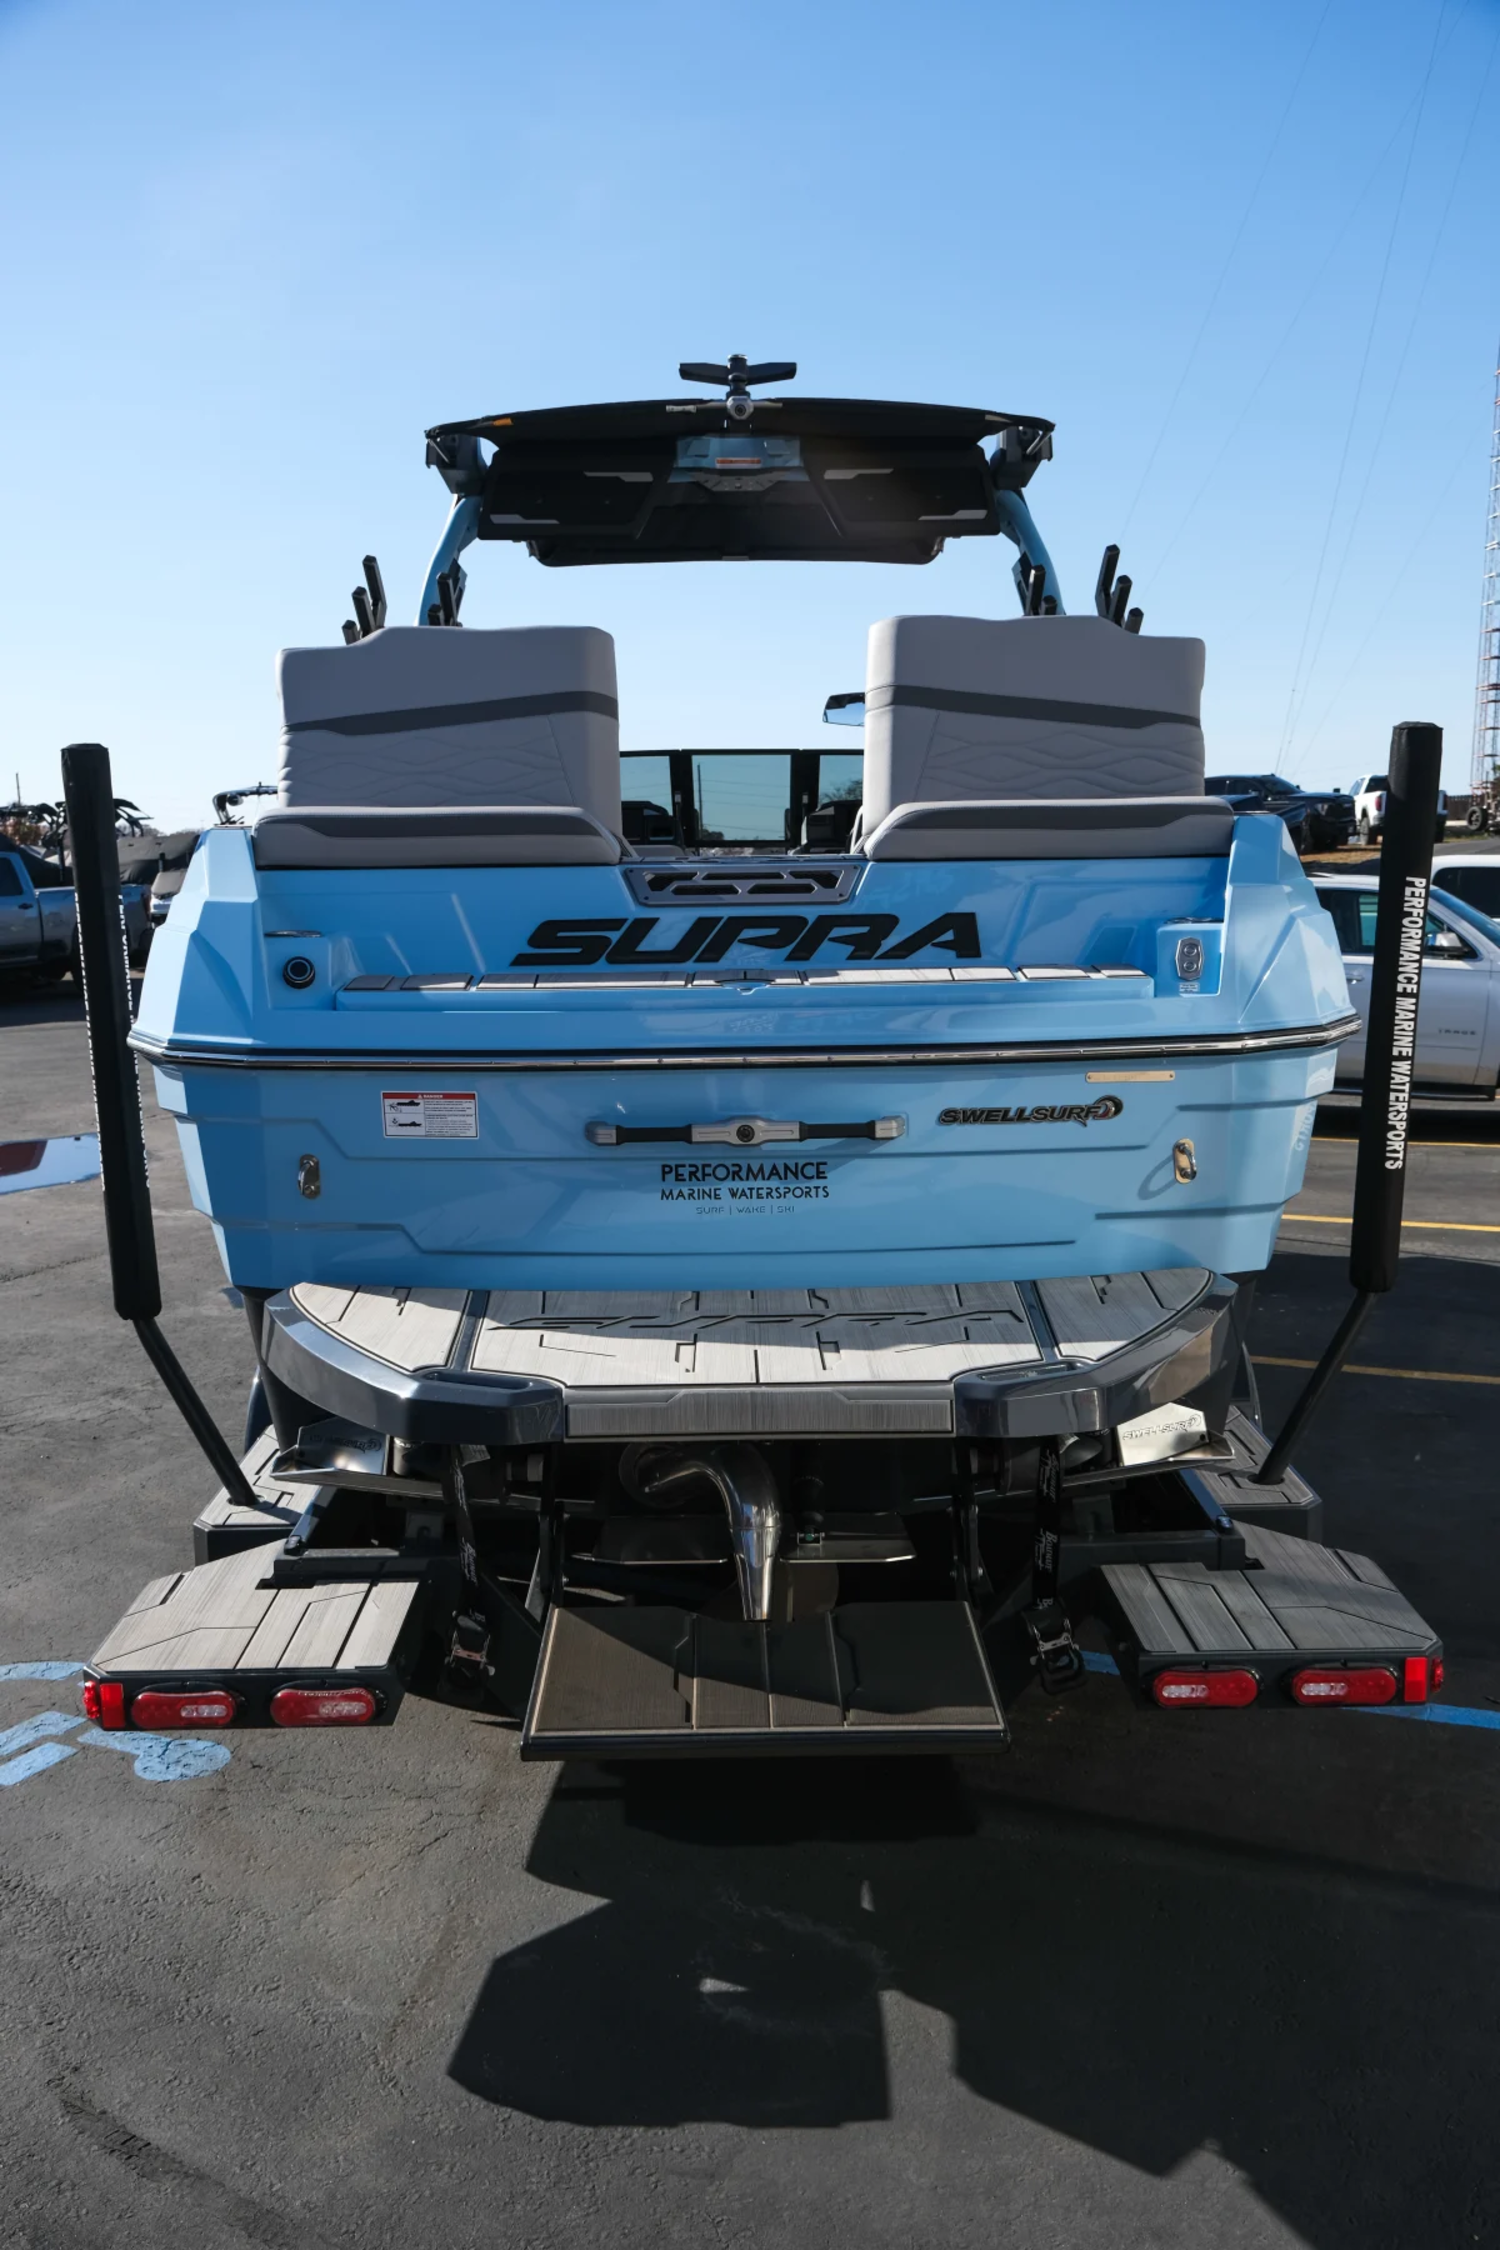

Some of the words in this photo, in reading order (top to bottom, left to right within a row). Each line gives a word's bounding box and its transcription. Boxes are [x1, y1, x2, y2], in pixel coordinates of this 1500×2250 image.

[509, 912, 982, 967] SUPRA
[1396, 876, 1427, 993] PERFORMANCE
[1392, 997, 1416, 1056] MARINE
[938, 1104, 1105, 1127] SWELLSURF
[1384, 1060, 1411, 1170] WATERSPORTS
[661, 1161, 828, 1182] PERFORMANCE
[660, 1187, 722, 1200] MARINE
[728, 1185, 830, 1200] WATERSPORTS
[696, 1206, 725, 1215] SURF
[736, 1205, 766, 1214] WAKE
[777, 1204, 795, 1213] SKI
[1122, 1419, 1193, 1441] SWELLSURF
